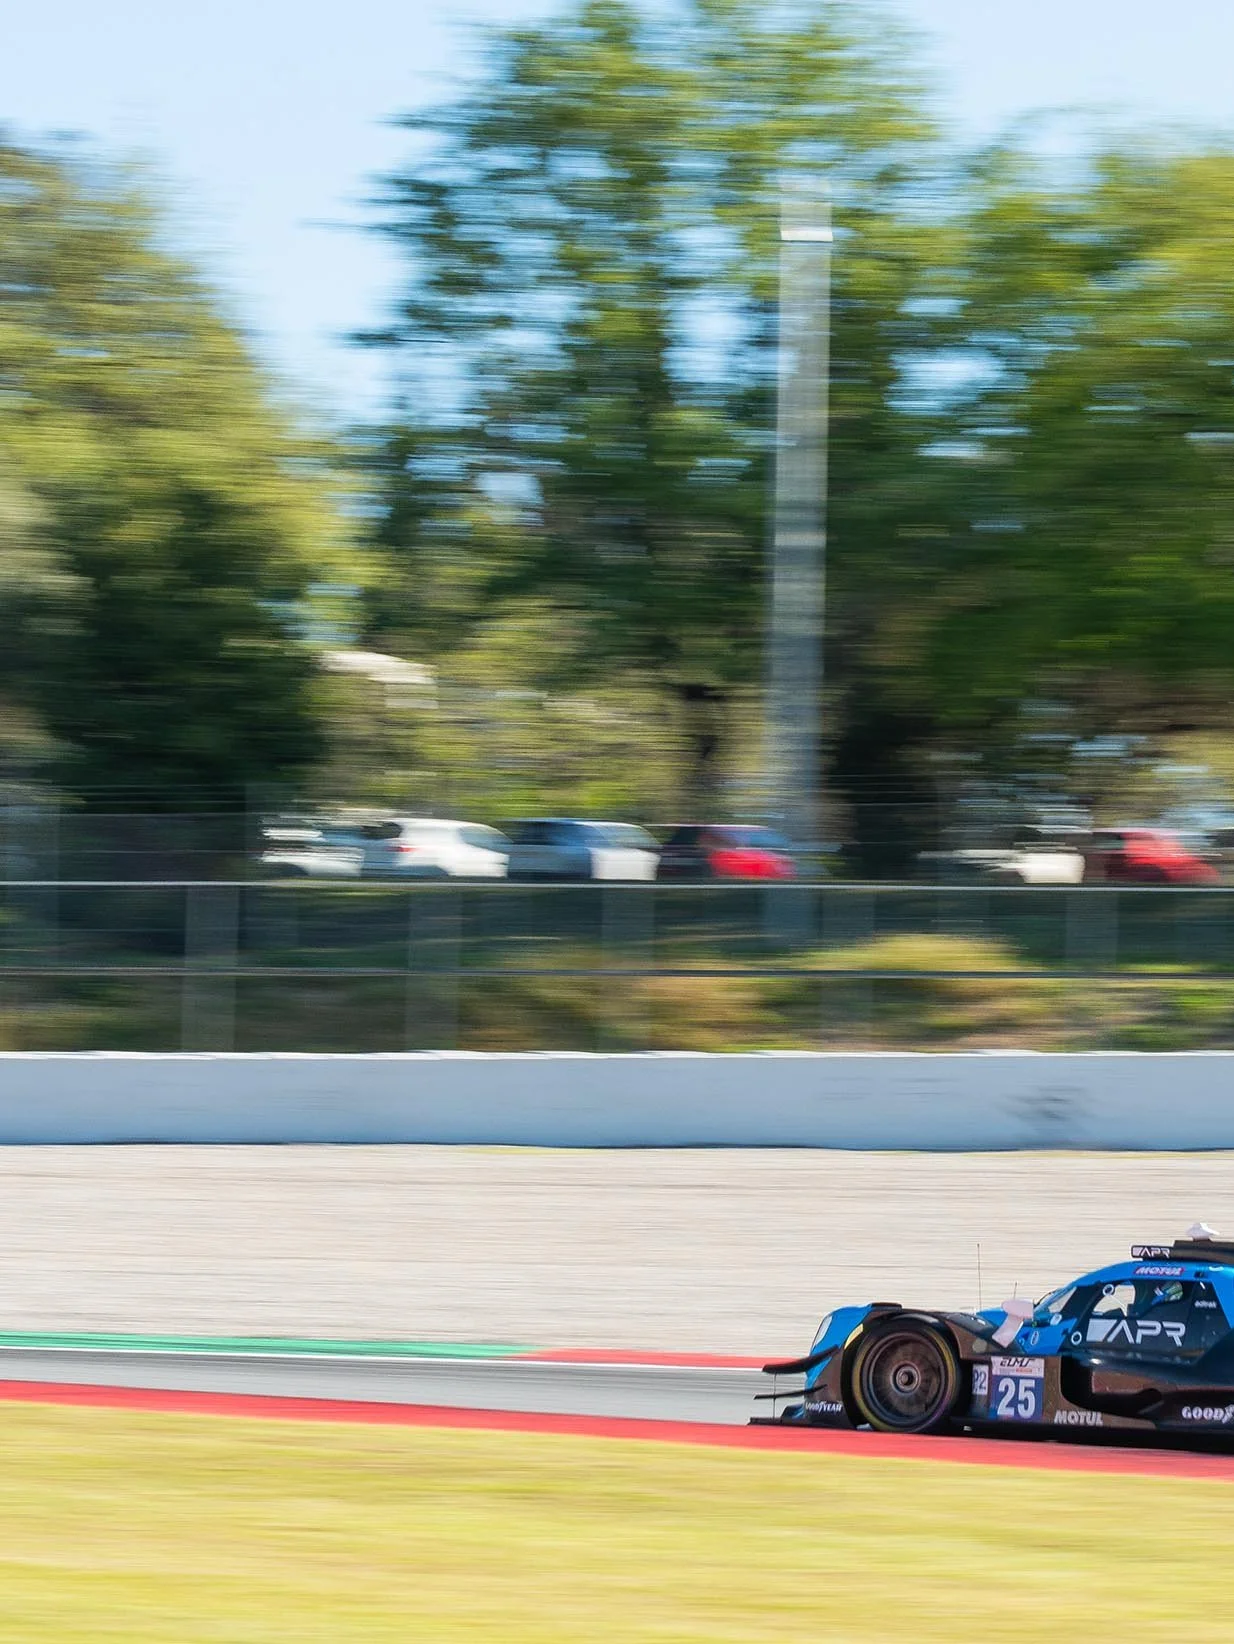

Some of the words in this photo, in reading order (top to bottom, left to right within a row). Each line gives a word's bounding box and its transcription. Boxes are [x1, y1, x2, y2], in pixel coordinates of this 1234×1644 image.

[1140, 1247, 1170, 1258] APR
[1135, 1266, 1182, 1276] MOTUL
[1107, 1319, 1186, 1347] APR
[997, 1377, 1036, 1419] 25
[1054, 1410, 1104, 1427] MOTUL
